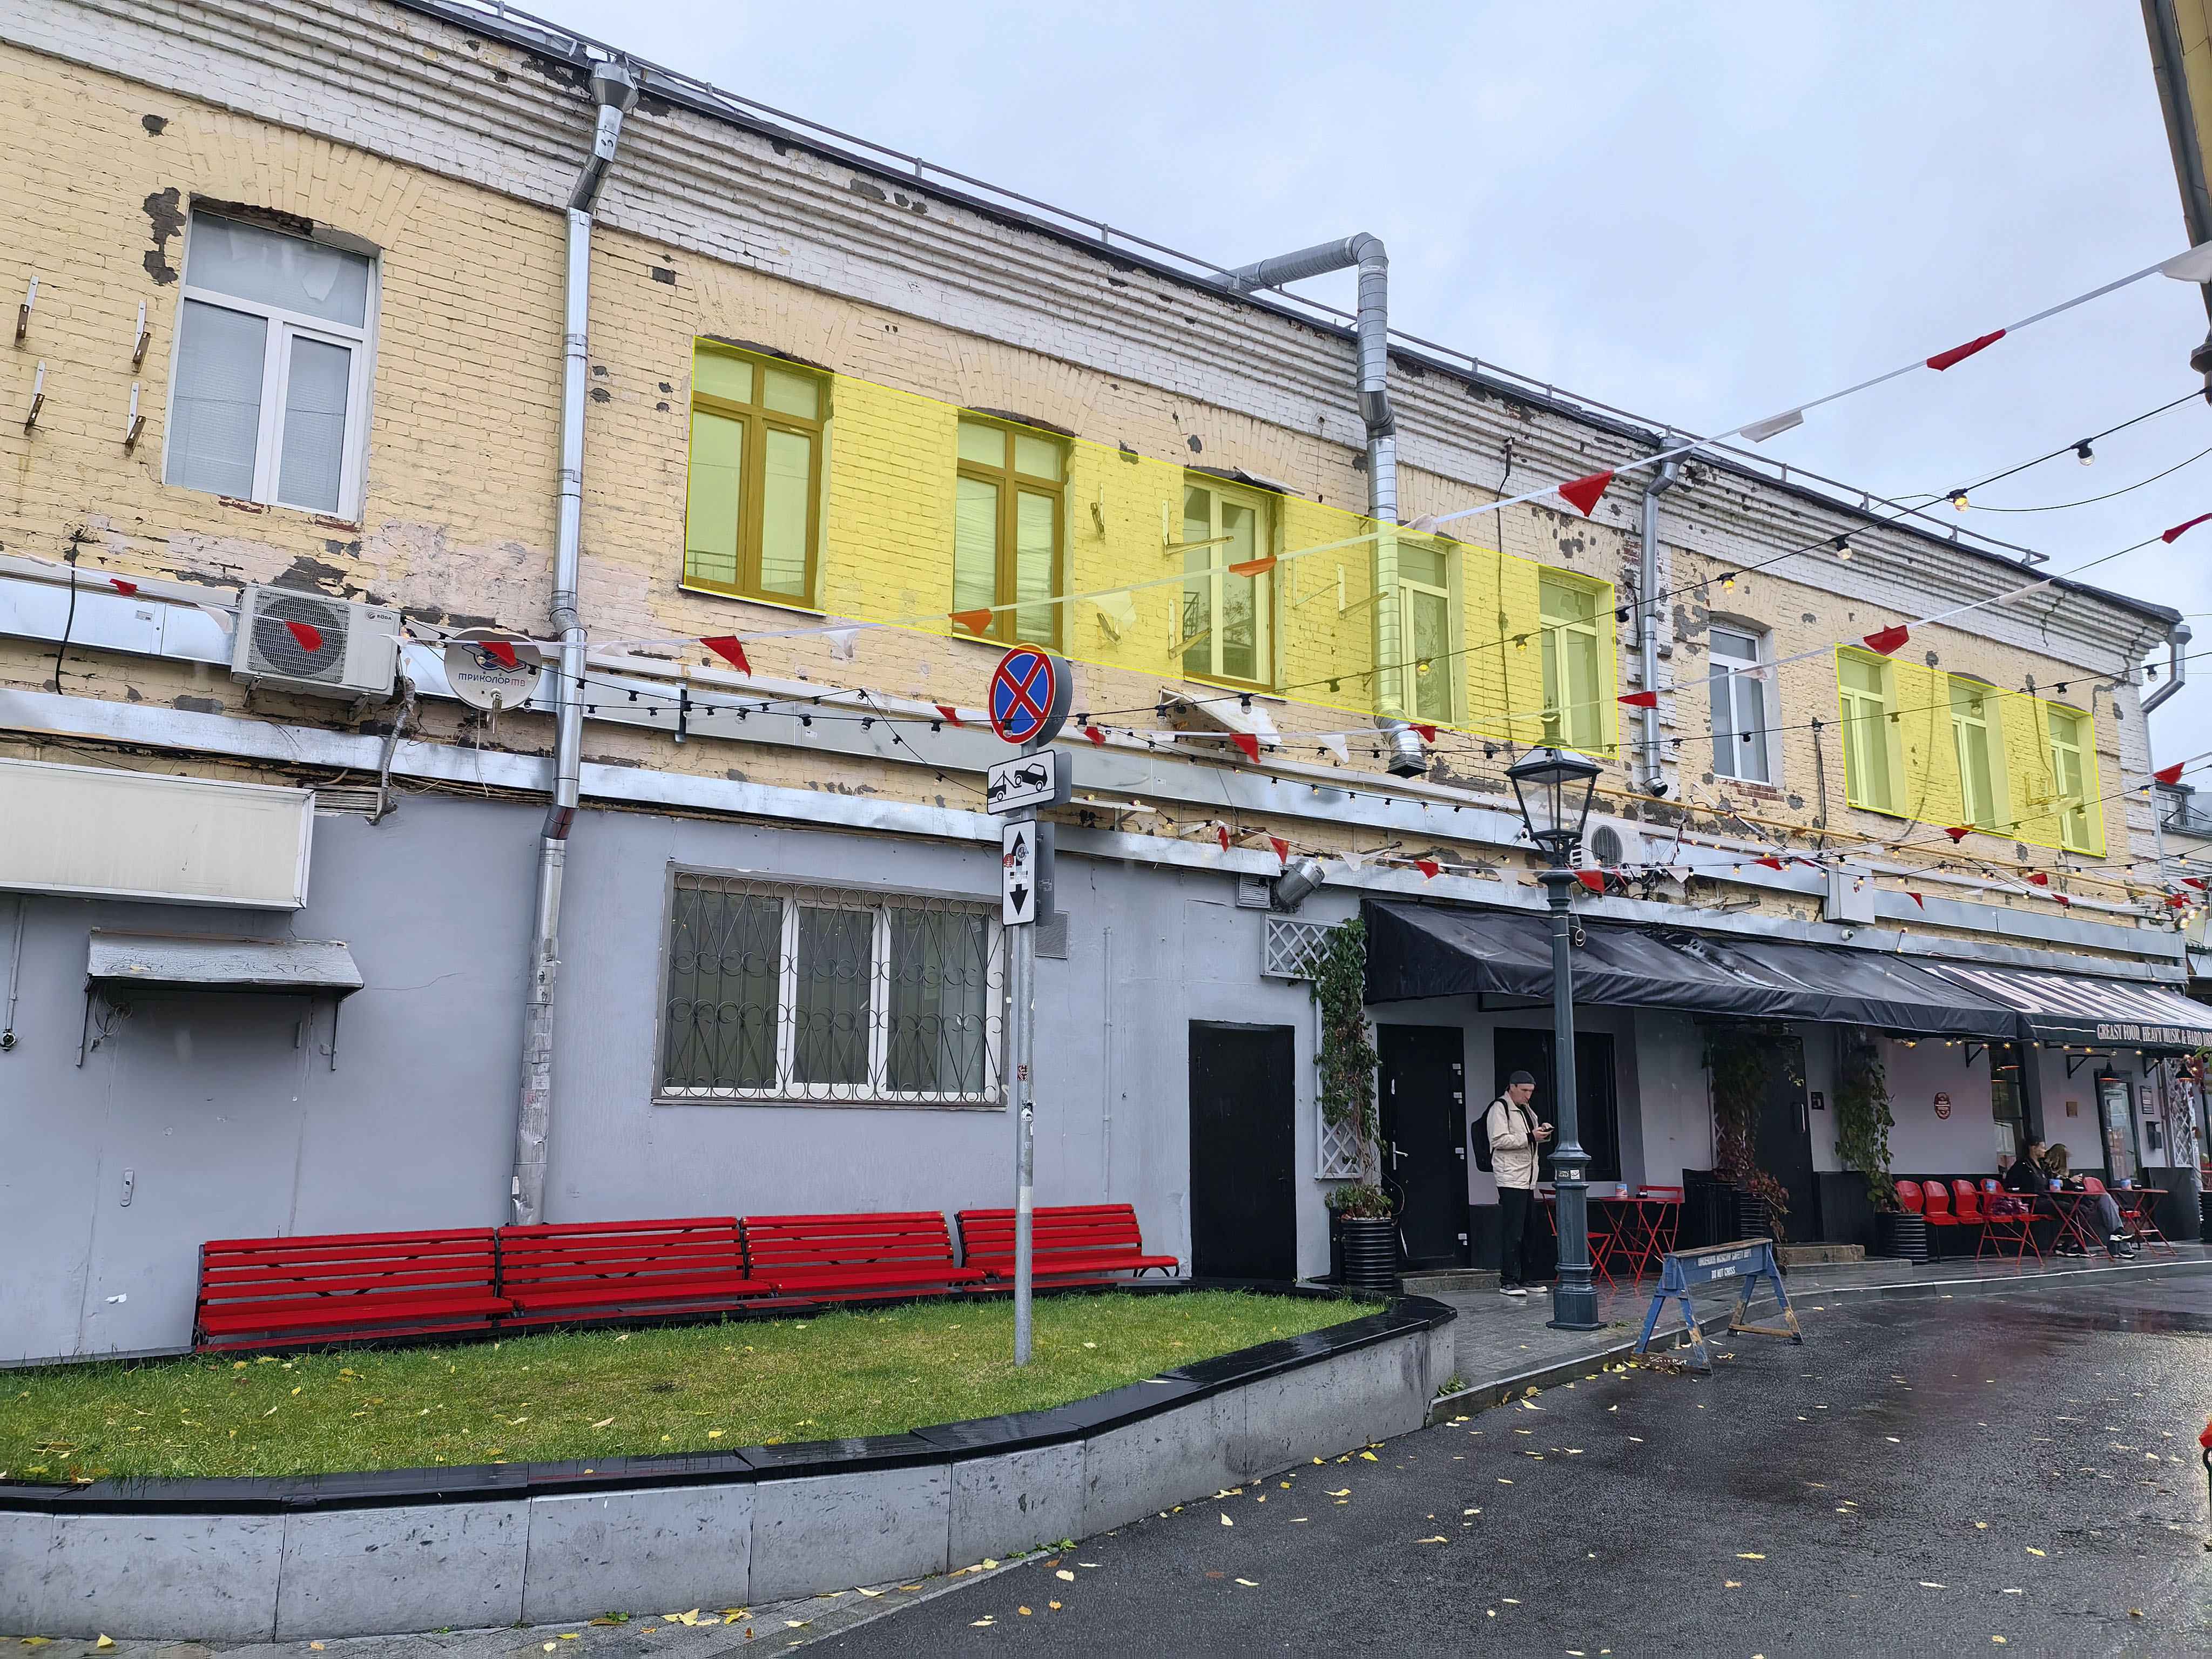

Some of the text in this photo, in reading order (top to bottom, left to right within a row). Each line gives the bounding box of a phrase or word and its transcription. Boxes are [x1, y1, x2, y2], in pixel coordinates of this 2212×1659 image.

[2098, 1024, 2123, 1040] GREASY
[2142, 1027, 2162, 1042] HEAVY
[2162, 1028, 2181, 1043] MUSIC
[2181, 1030, 2187, 1044] &
[2187, 1030, 2202, 1046] HARD
